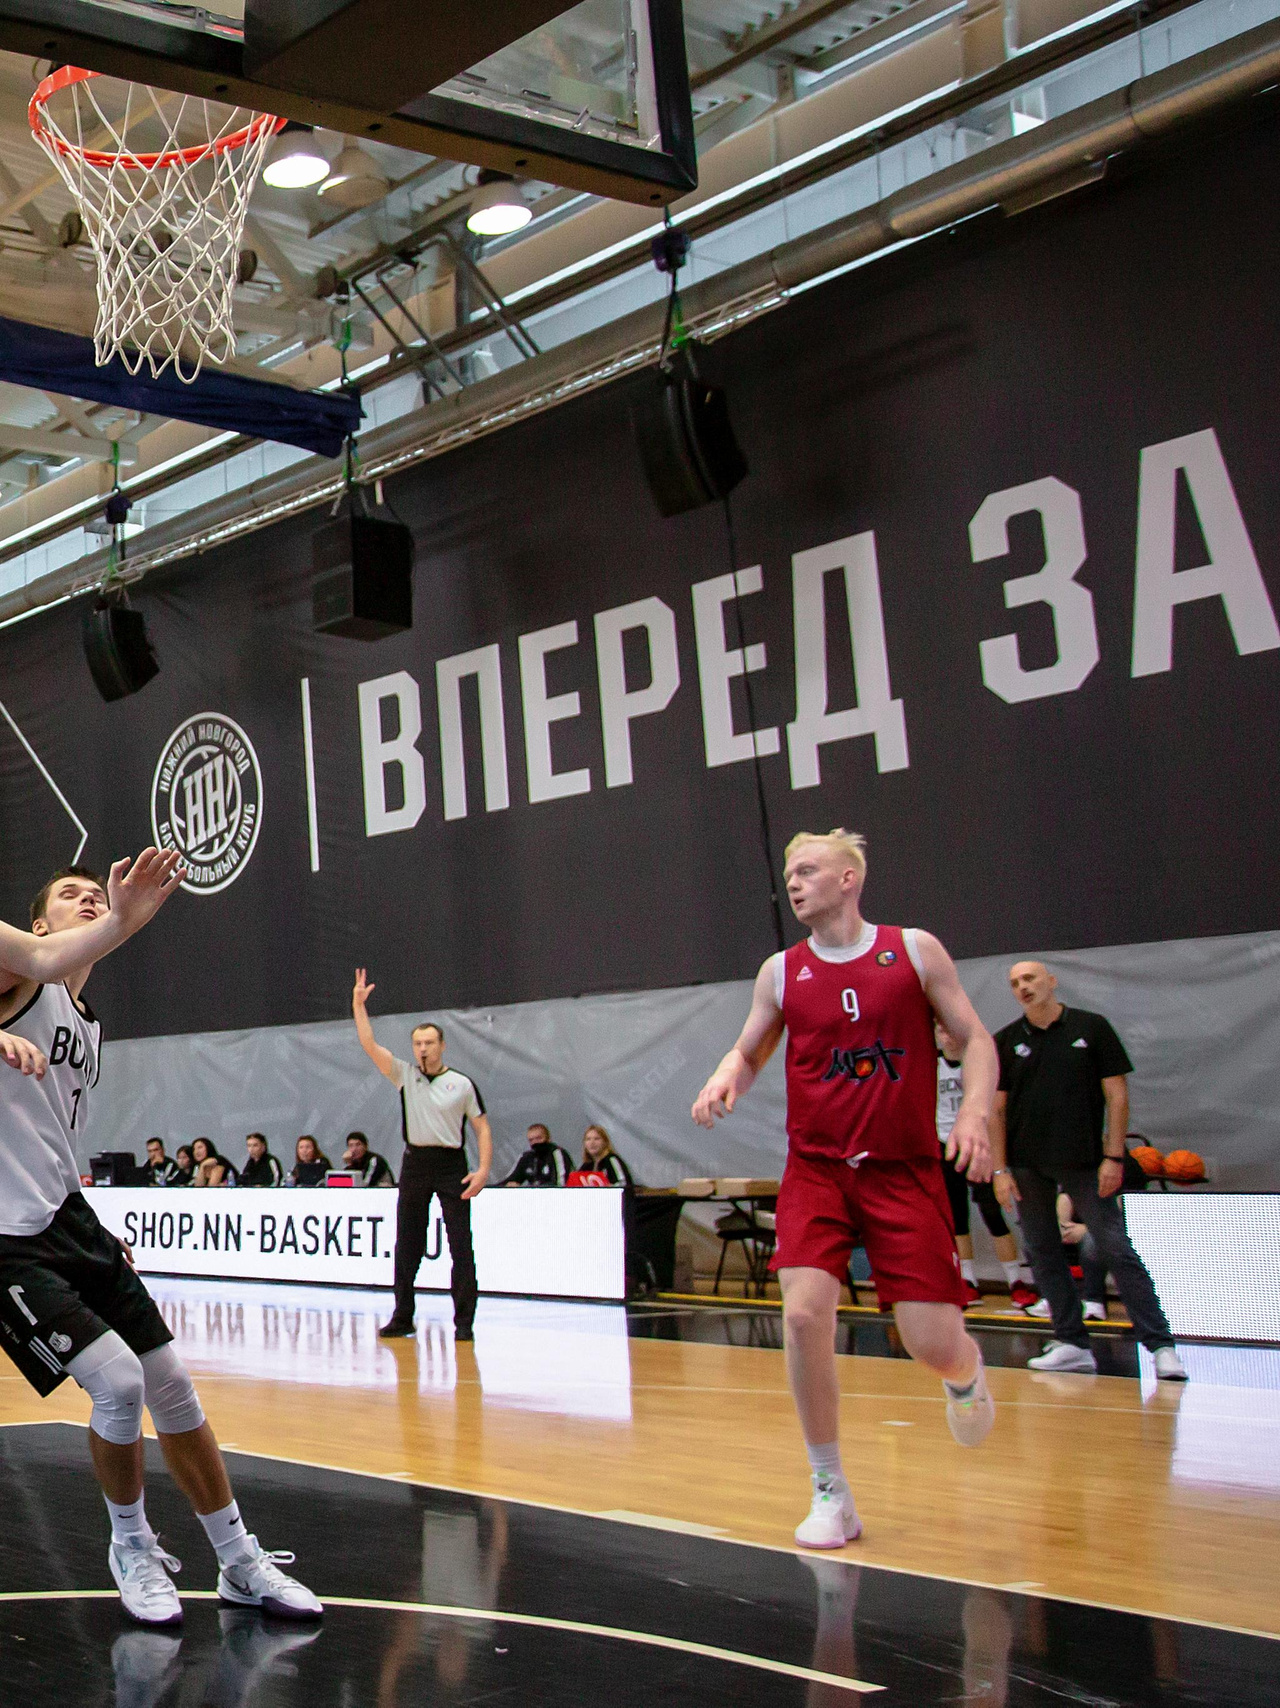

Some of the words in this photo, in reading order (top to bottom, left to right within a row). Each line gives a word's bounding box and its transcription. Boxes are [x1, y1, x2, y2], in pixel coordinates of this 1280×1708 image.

[358, 530, 910, 837] ВПЕРЕД
[968, 428, 1280, 704] ЗА
[840, 987, 861, 1022] 9
[124, 1211, 443, 1261] SHOP.NN-BASKET.U
